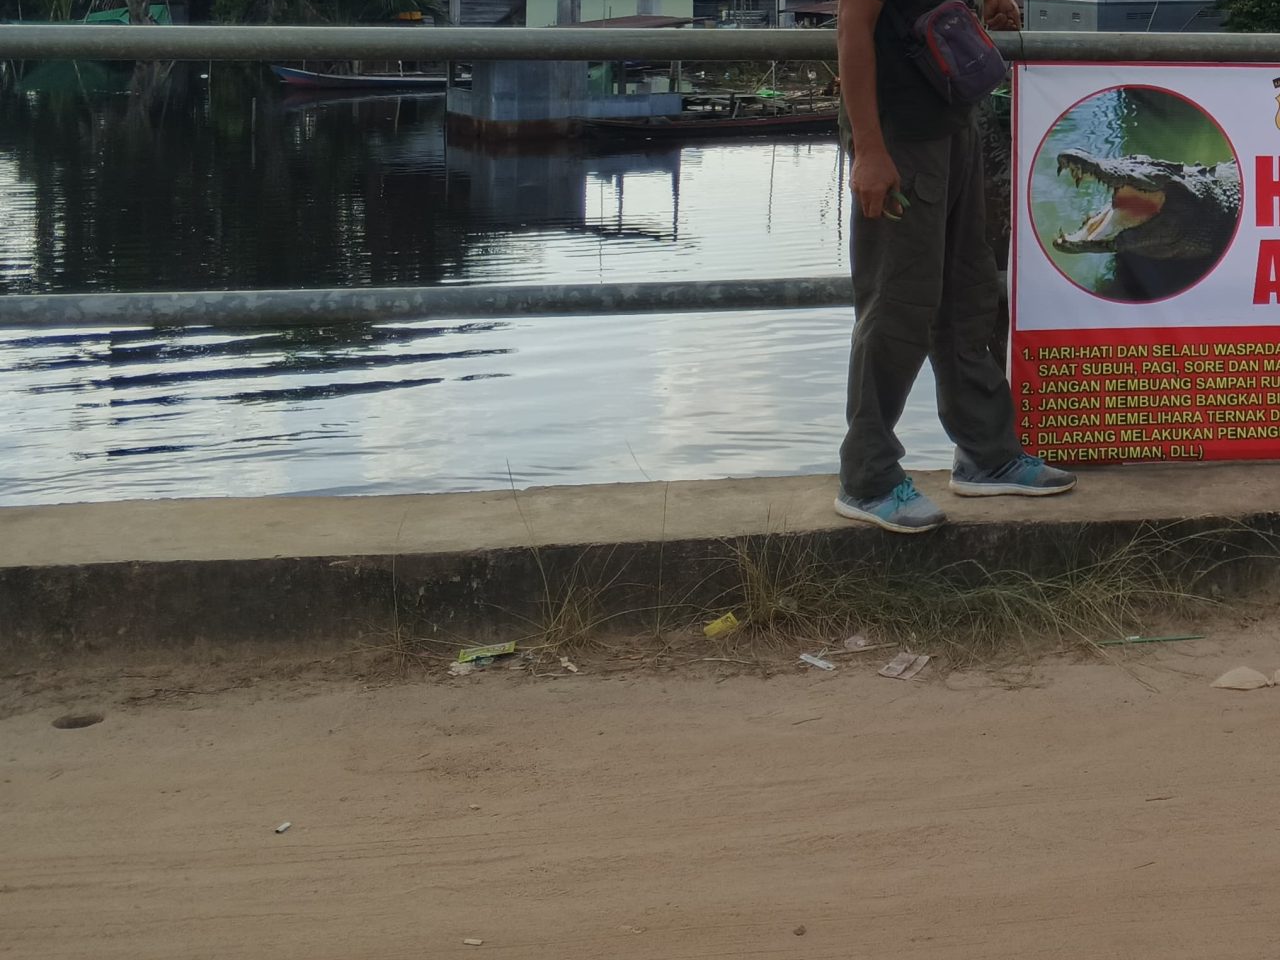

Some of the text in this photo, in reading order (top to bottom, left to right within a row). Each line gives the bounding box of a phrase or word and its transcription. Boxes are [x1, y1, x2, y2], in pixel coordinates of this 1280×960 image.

[1022, 348, 1035, 361] 1.
[1039, 346, 1113, 360] HARI-HATI
[1117, 344, 1148, 358] DAN
[1152, 344, 1209, 357] SELALU
[1038, 363, 1078, 377] SAAT
[1082, 362, 1138, 378] SUBUH,
[1142, 360, 1180, 375] PAGI,
[1184, 360, 1224, 373] SORE
[1228, 359, 1259, 372] DAN
[1021, 382, 1034, 394] 2.
[1038, 380, 1100, 394] JANGAN
[1105, 377, 1192, 392] MEMBUANG
[1196, 376, 1256, 390] SAMPAH
[1021, 399, 1034, 411] 3.
[1038, 396, 1100, 411] JANGAN
[1104, 394, 1192, 408] MEMBUANG
[1196, 392, 1262, 406] BANGKAI
[1021, 416, 1034, 428] 4.
[1038, 414, 1100, 428] JANGAN
[1104, 410, 1204, 426] MEMELIHARA
[1206, 409, 1266, 423] TERNAK
[1021, 433, 1034, 445] 5.
[1038, 430, 1116, 445] DILARANG
[1120, 427, 1213, 442] MELAKUKAN
[1038, 444, 1203, 461] PENYENTRUMAN, DLL)
